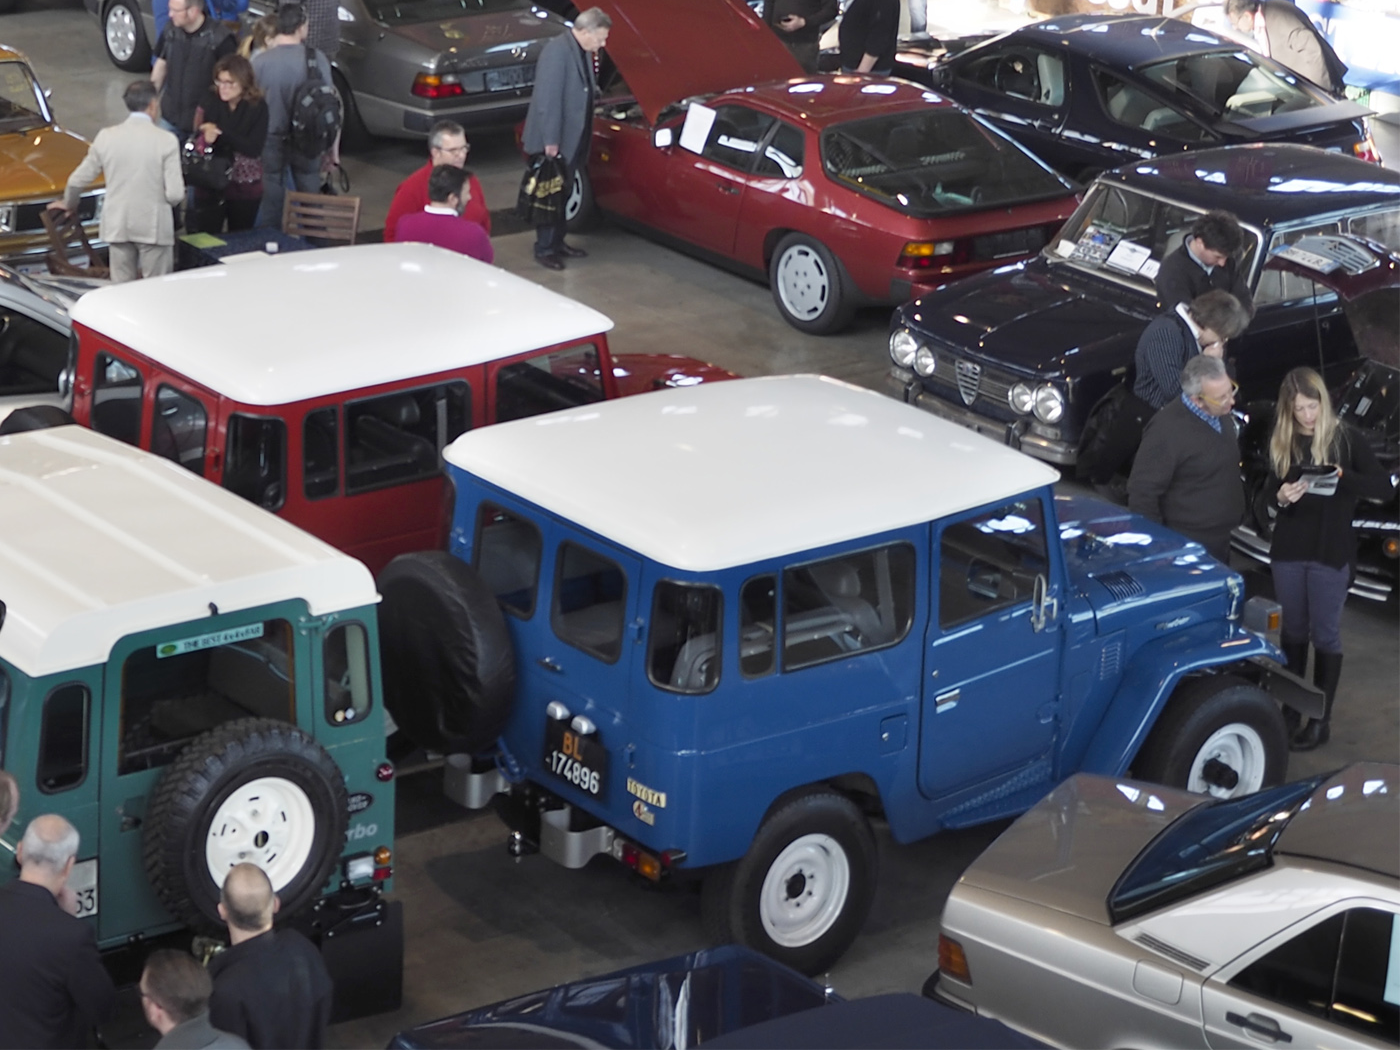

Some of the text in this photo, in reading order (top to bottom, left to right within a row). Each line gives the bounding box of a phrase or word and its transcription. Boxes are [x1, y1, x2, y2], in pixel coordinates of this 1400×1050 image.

[563, 731, 584, 761] BL
[629, 779, 662, 807] TOYOTA
[345, 823, 378, 841] rbo
